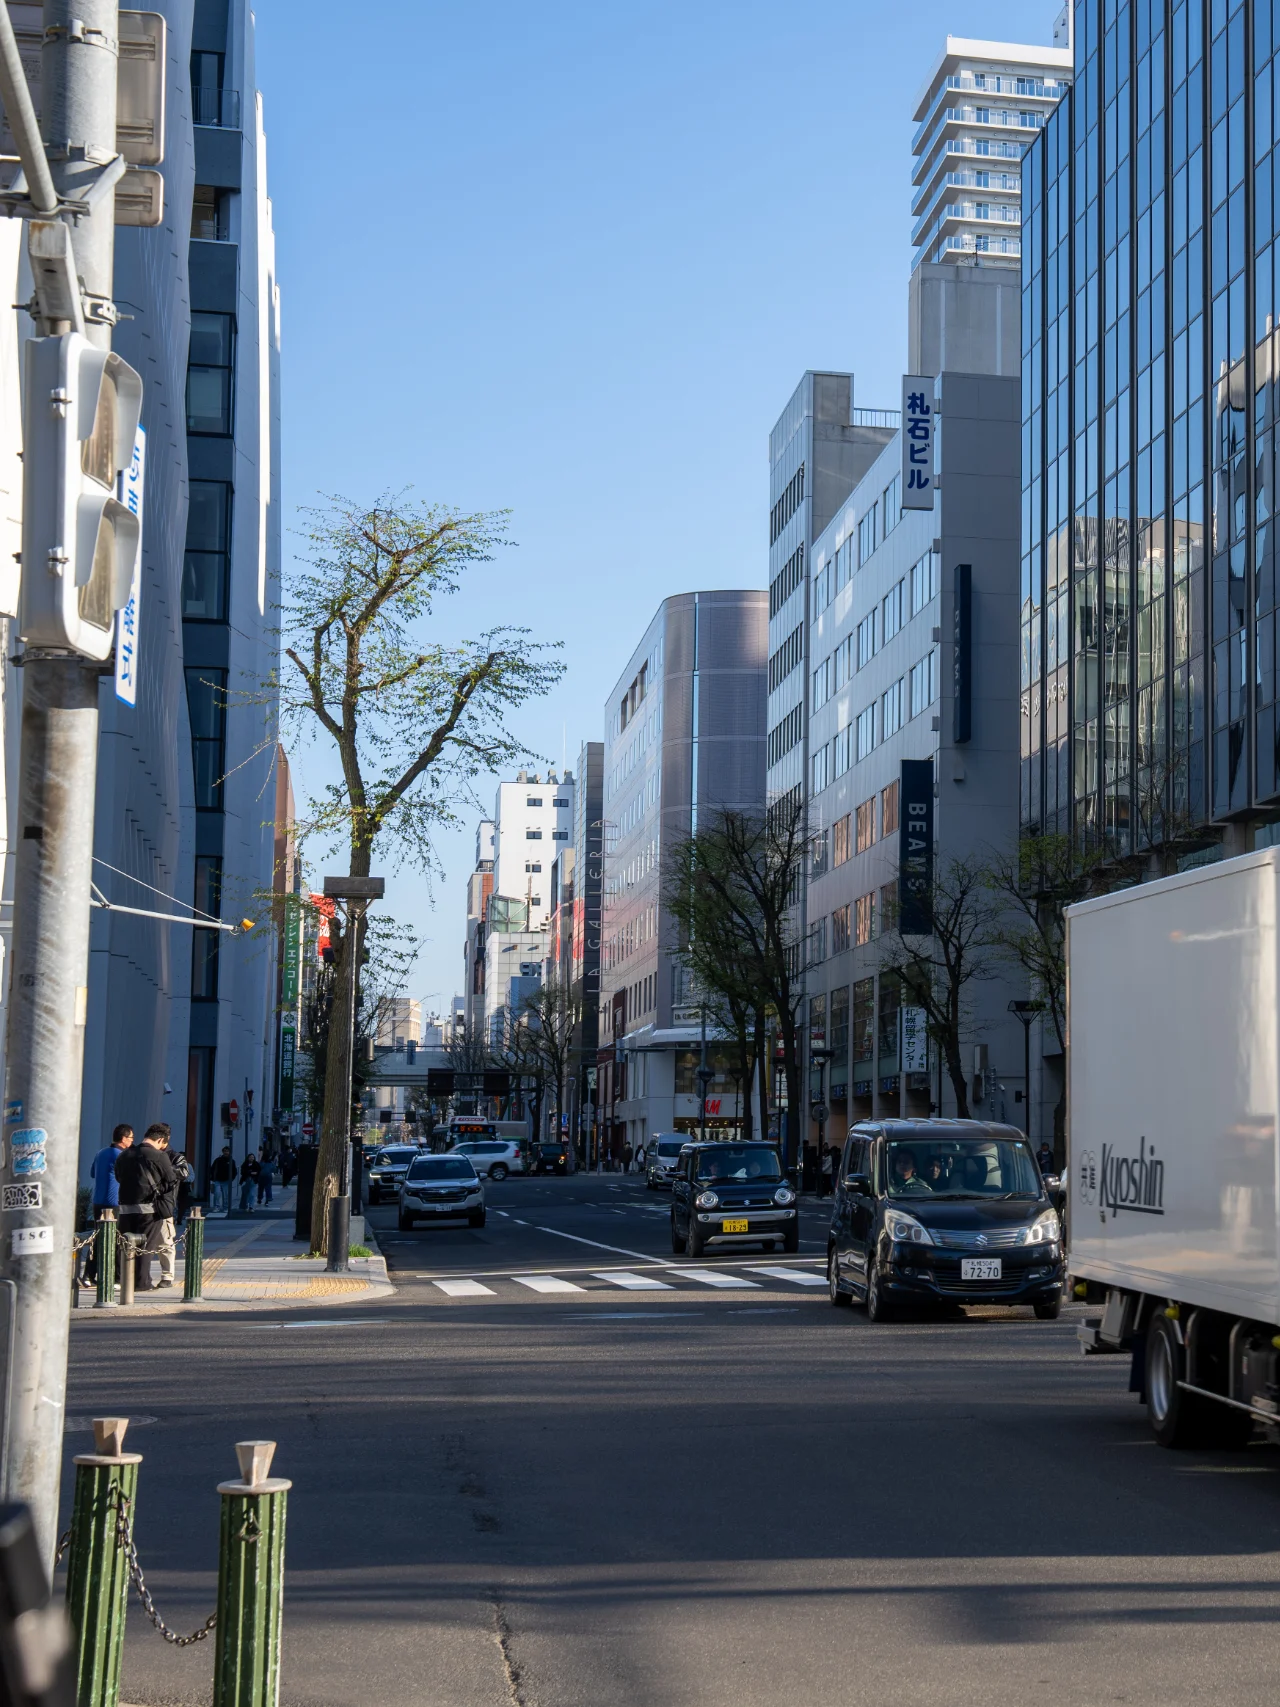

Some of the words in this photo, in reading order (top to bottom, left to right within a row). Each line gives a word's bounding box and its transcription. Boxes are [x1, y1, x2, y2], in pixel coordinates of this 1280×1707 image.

[907, 391, 931, 490] 札石ビル
[908, 802, 927, 891] BEAMS
[283, 1033, 294, 1078] 北海道銀行
[1100, 1136, 1164, 1218] Kyoshin
[970, 1267, 999, 1278] 72-70
